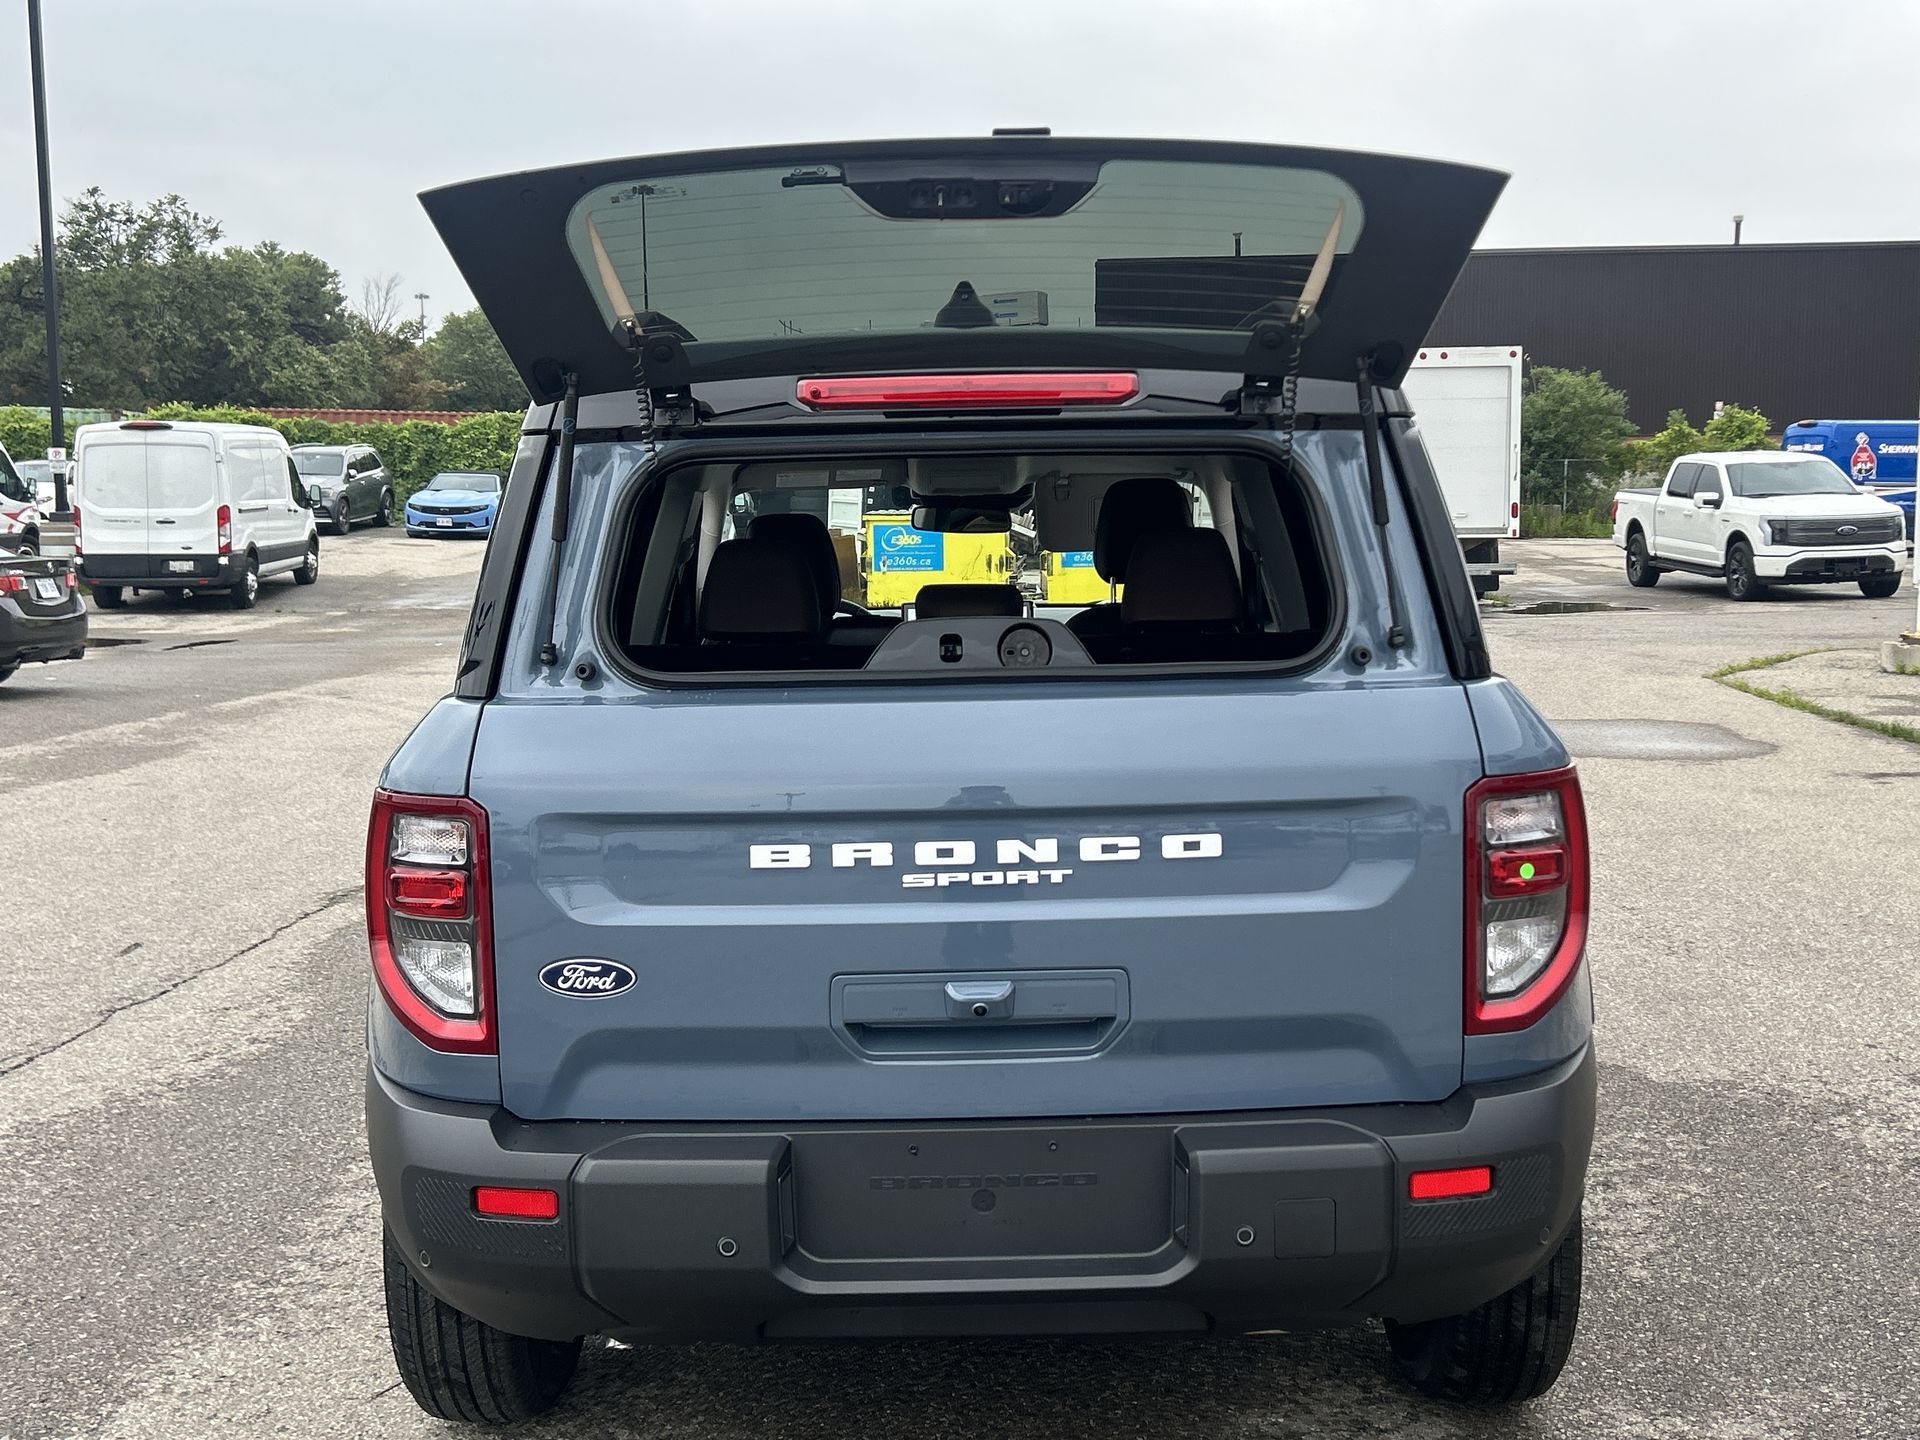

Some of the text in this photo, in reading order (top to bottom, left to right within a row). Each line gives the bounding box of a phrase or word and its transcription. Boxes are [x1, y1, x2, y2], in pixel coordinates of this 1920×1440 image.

[748, 832, 1223, 870] BRONCO
[901, 868, 1074, 889] SPORT
[557, 963, 617, 990] Ford
[869, 1173, 1098, 1190] BRONCO
